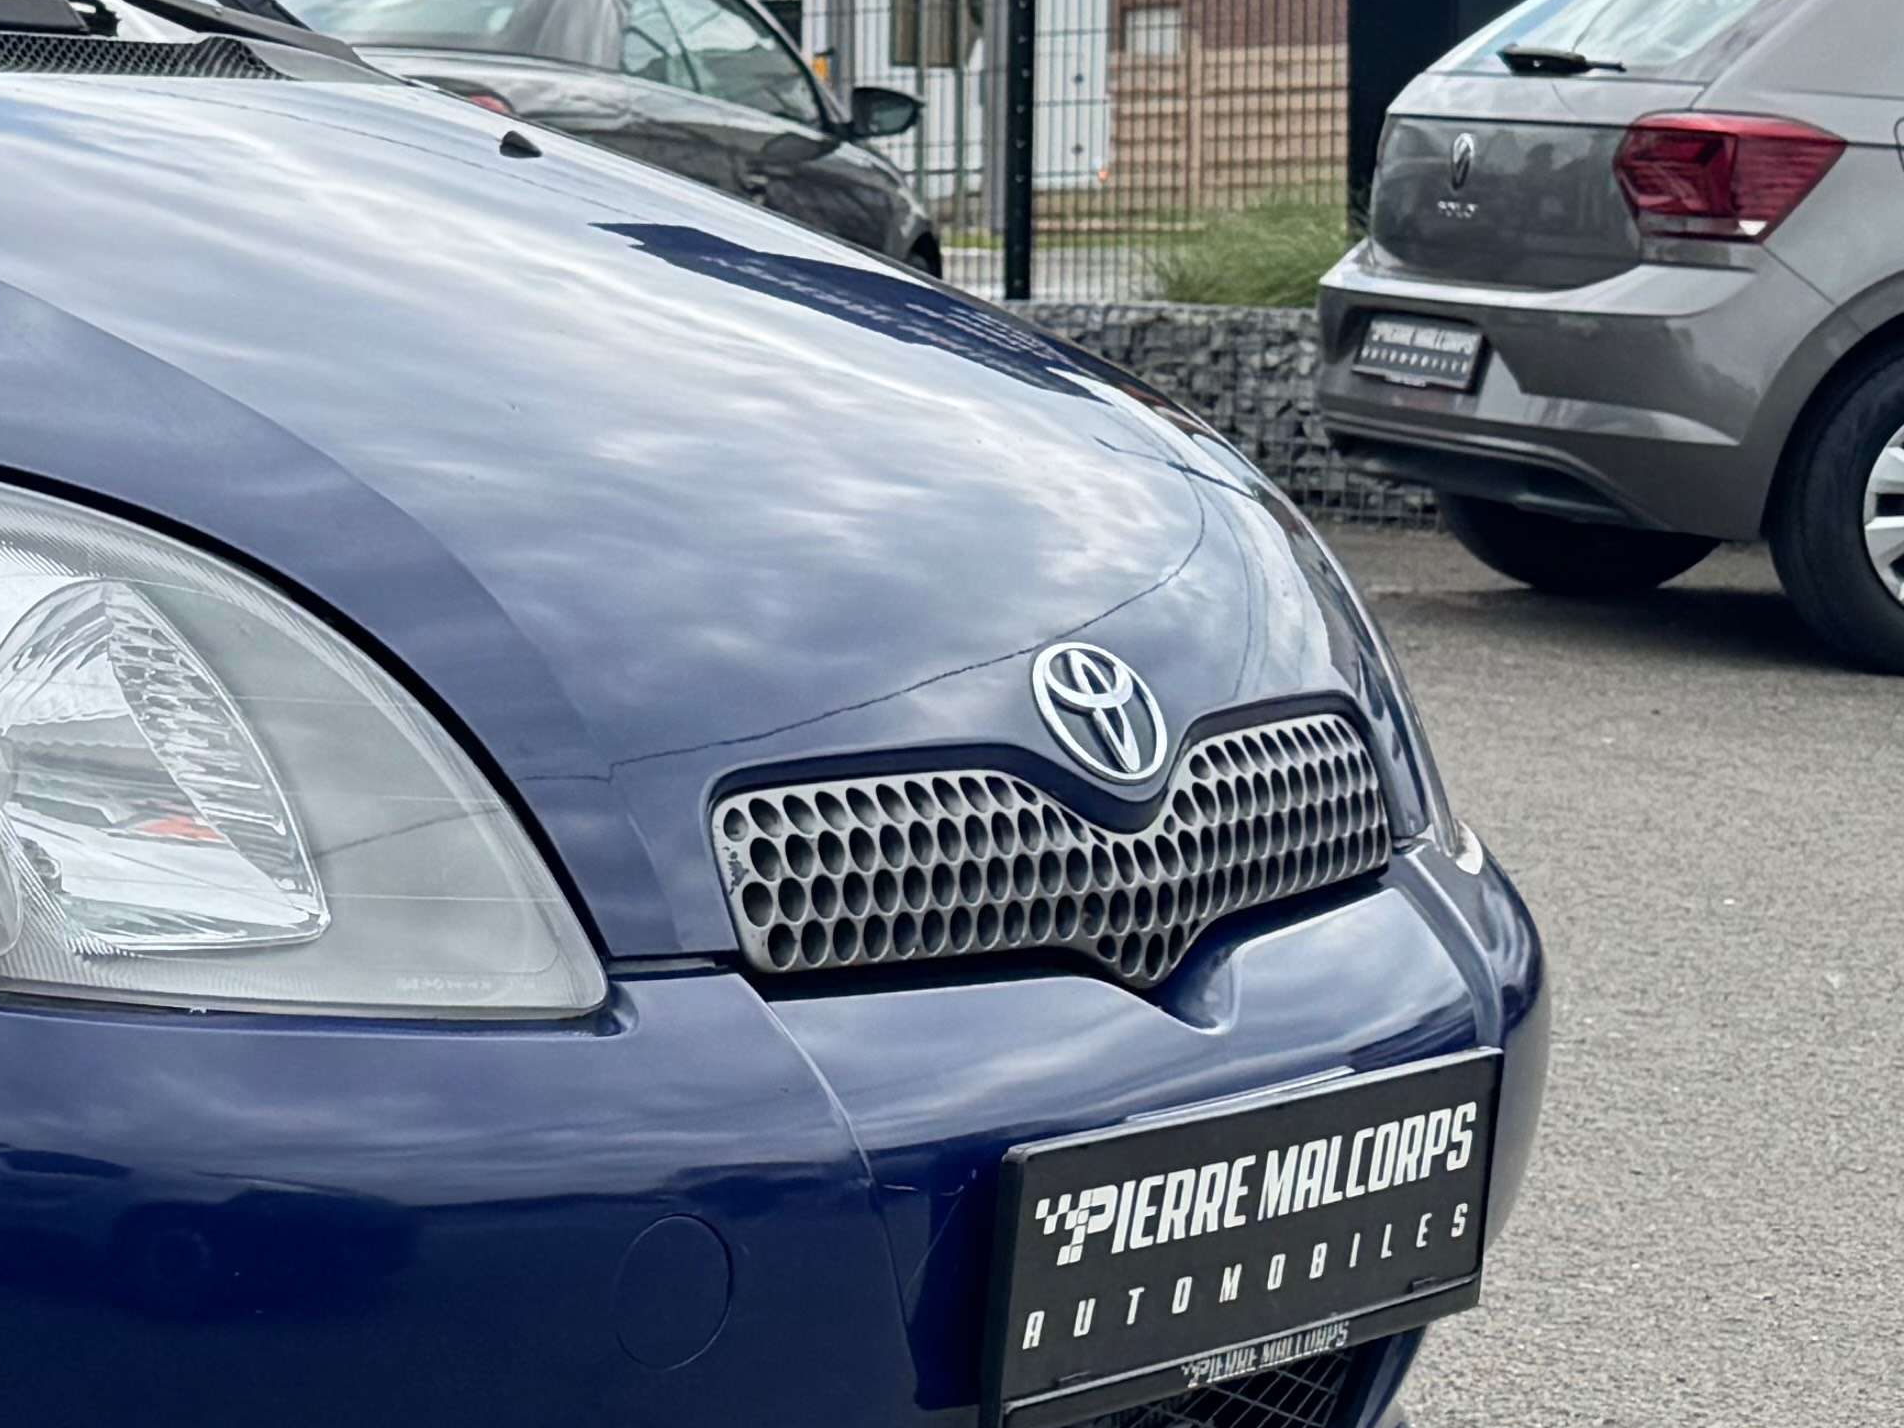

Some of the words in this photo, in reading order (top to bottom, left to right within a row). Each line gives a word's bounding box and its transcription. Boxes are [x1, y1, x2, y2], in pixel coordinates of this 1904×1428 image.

[1057, 1154, 1257, 1267] PIERRE
[1257, 1101, 1477, 1222] MALCORPS
[1022, 1202, 1469, 1350] AUTOMOBILES
